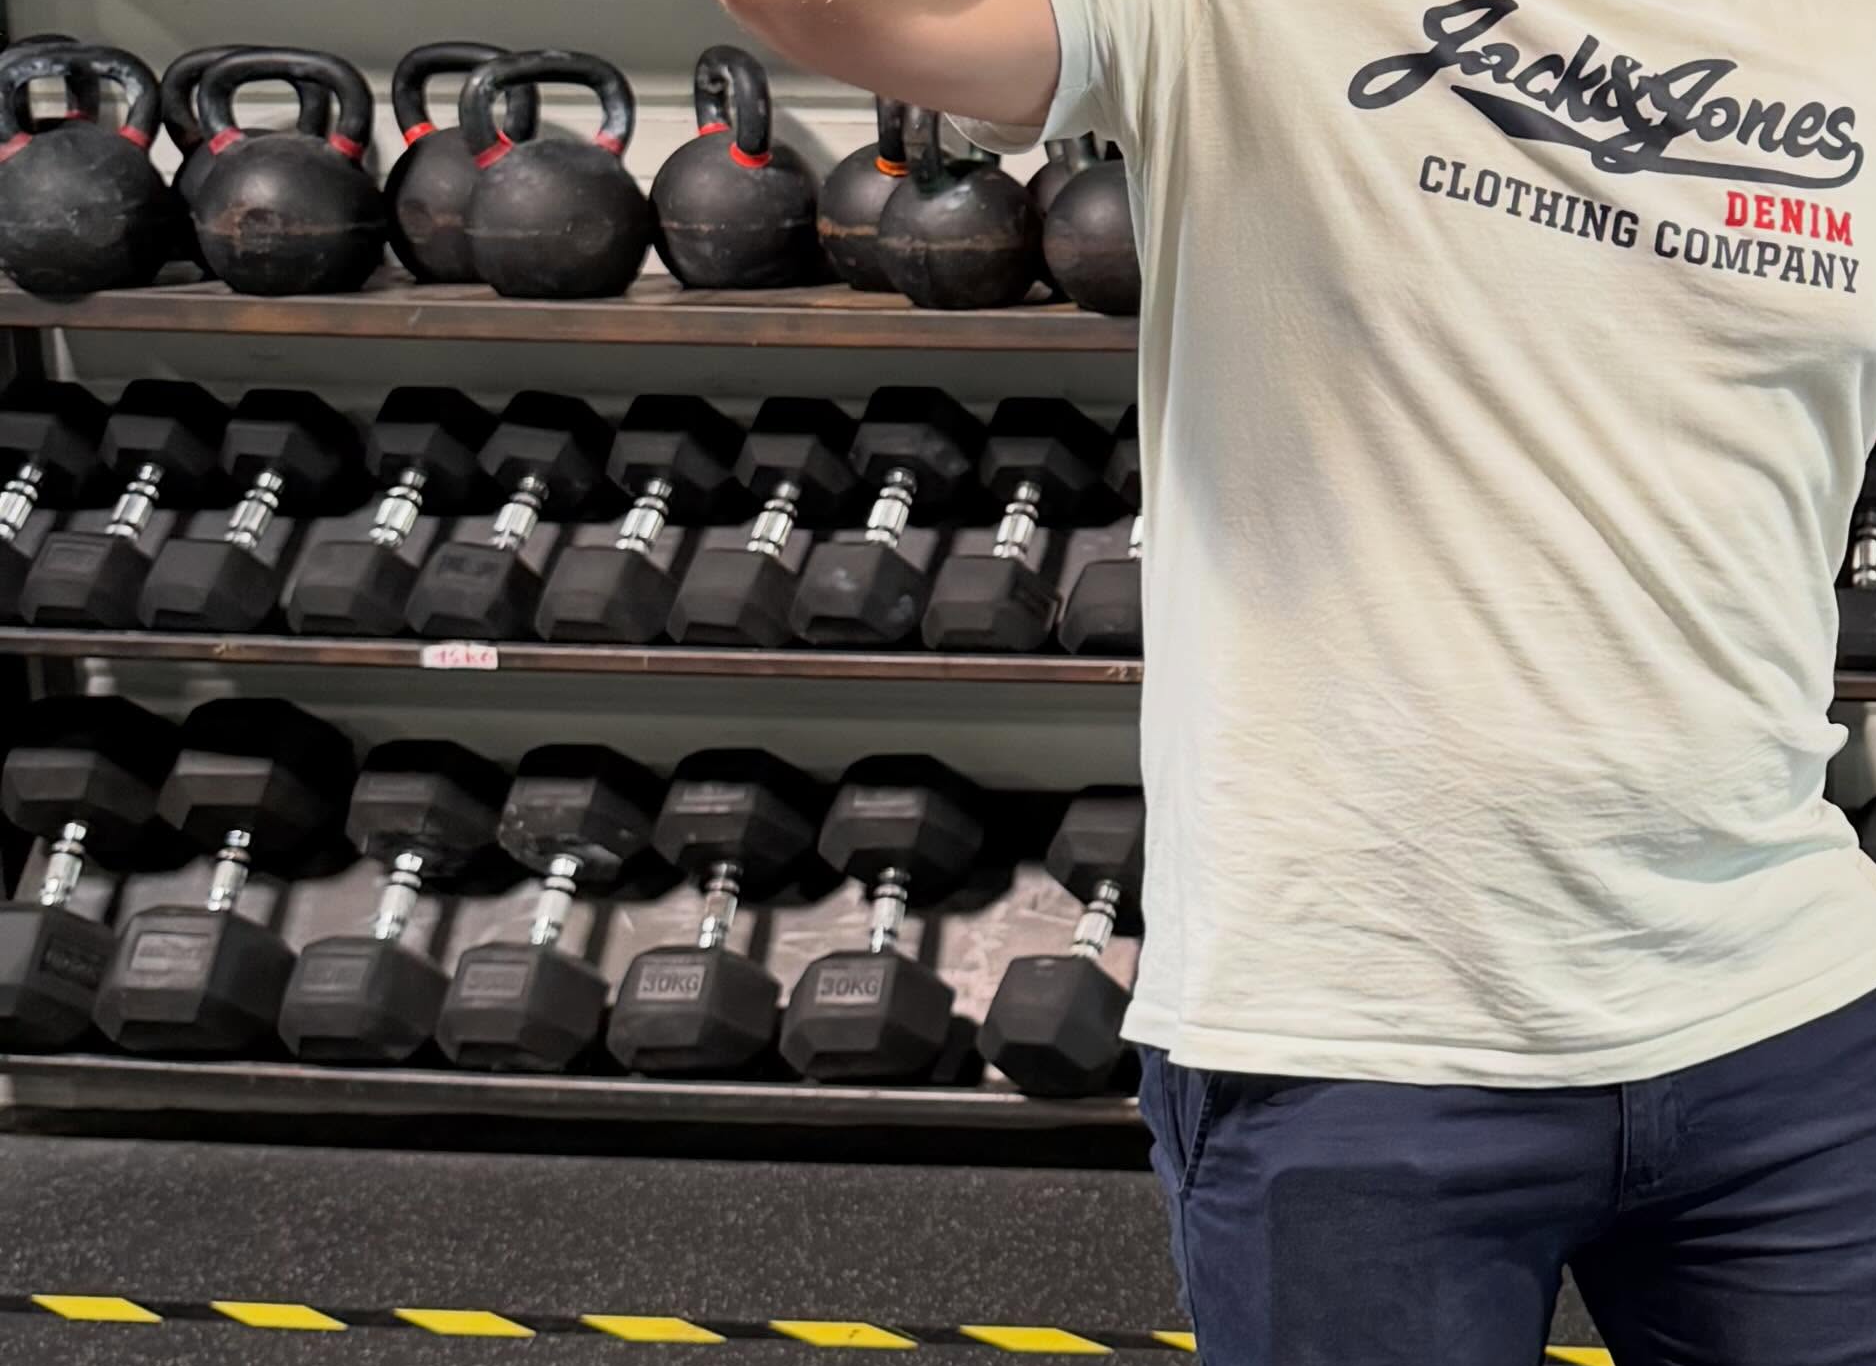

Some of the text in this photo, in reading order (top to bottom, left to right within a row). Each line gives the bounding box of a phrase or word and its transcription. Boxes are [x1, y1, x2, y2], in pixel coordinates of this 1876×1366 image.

[1418, 154, 1860, 295] CLOTHING COMPANY
[1725, 189, 1854, 247] DENIM
[642, 972, 699, 994] 30KG
[820, 975, 880, 996] 30KG
